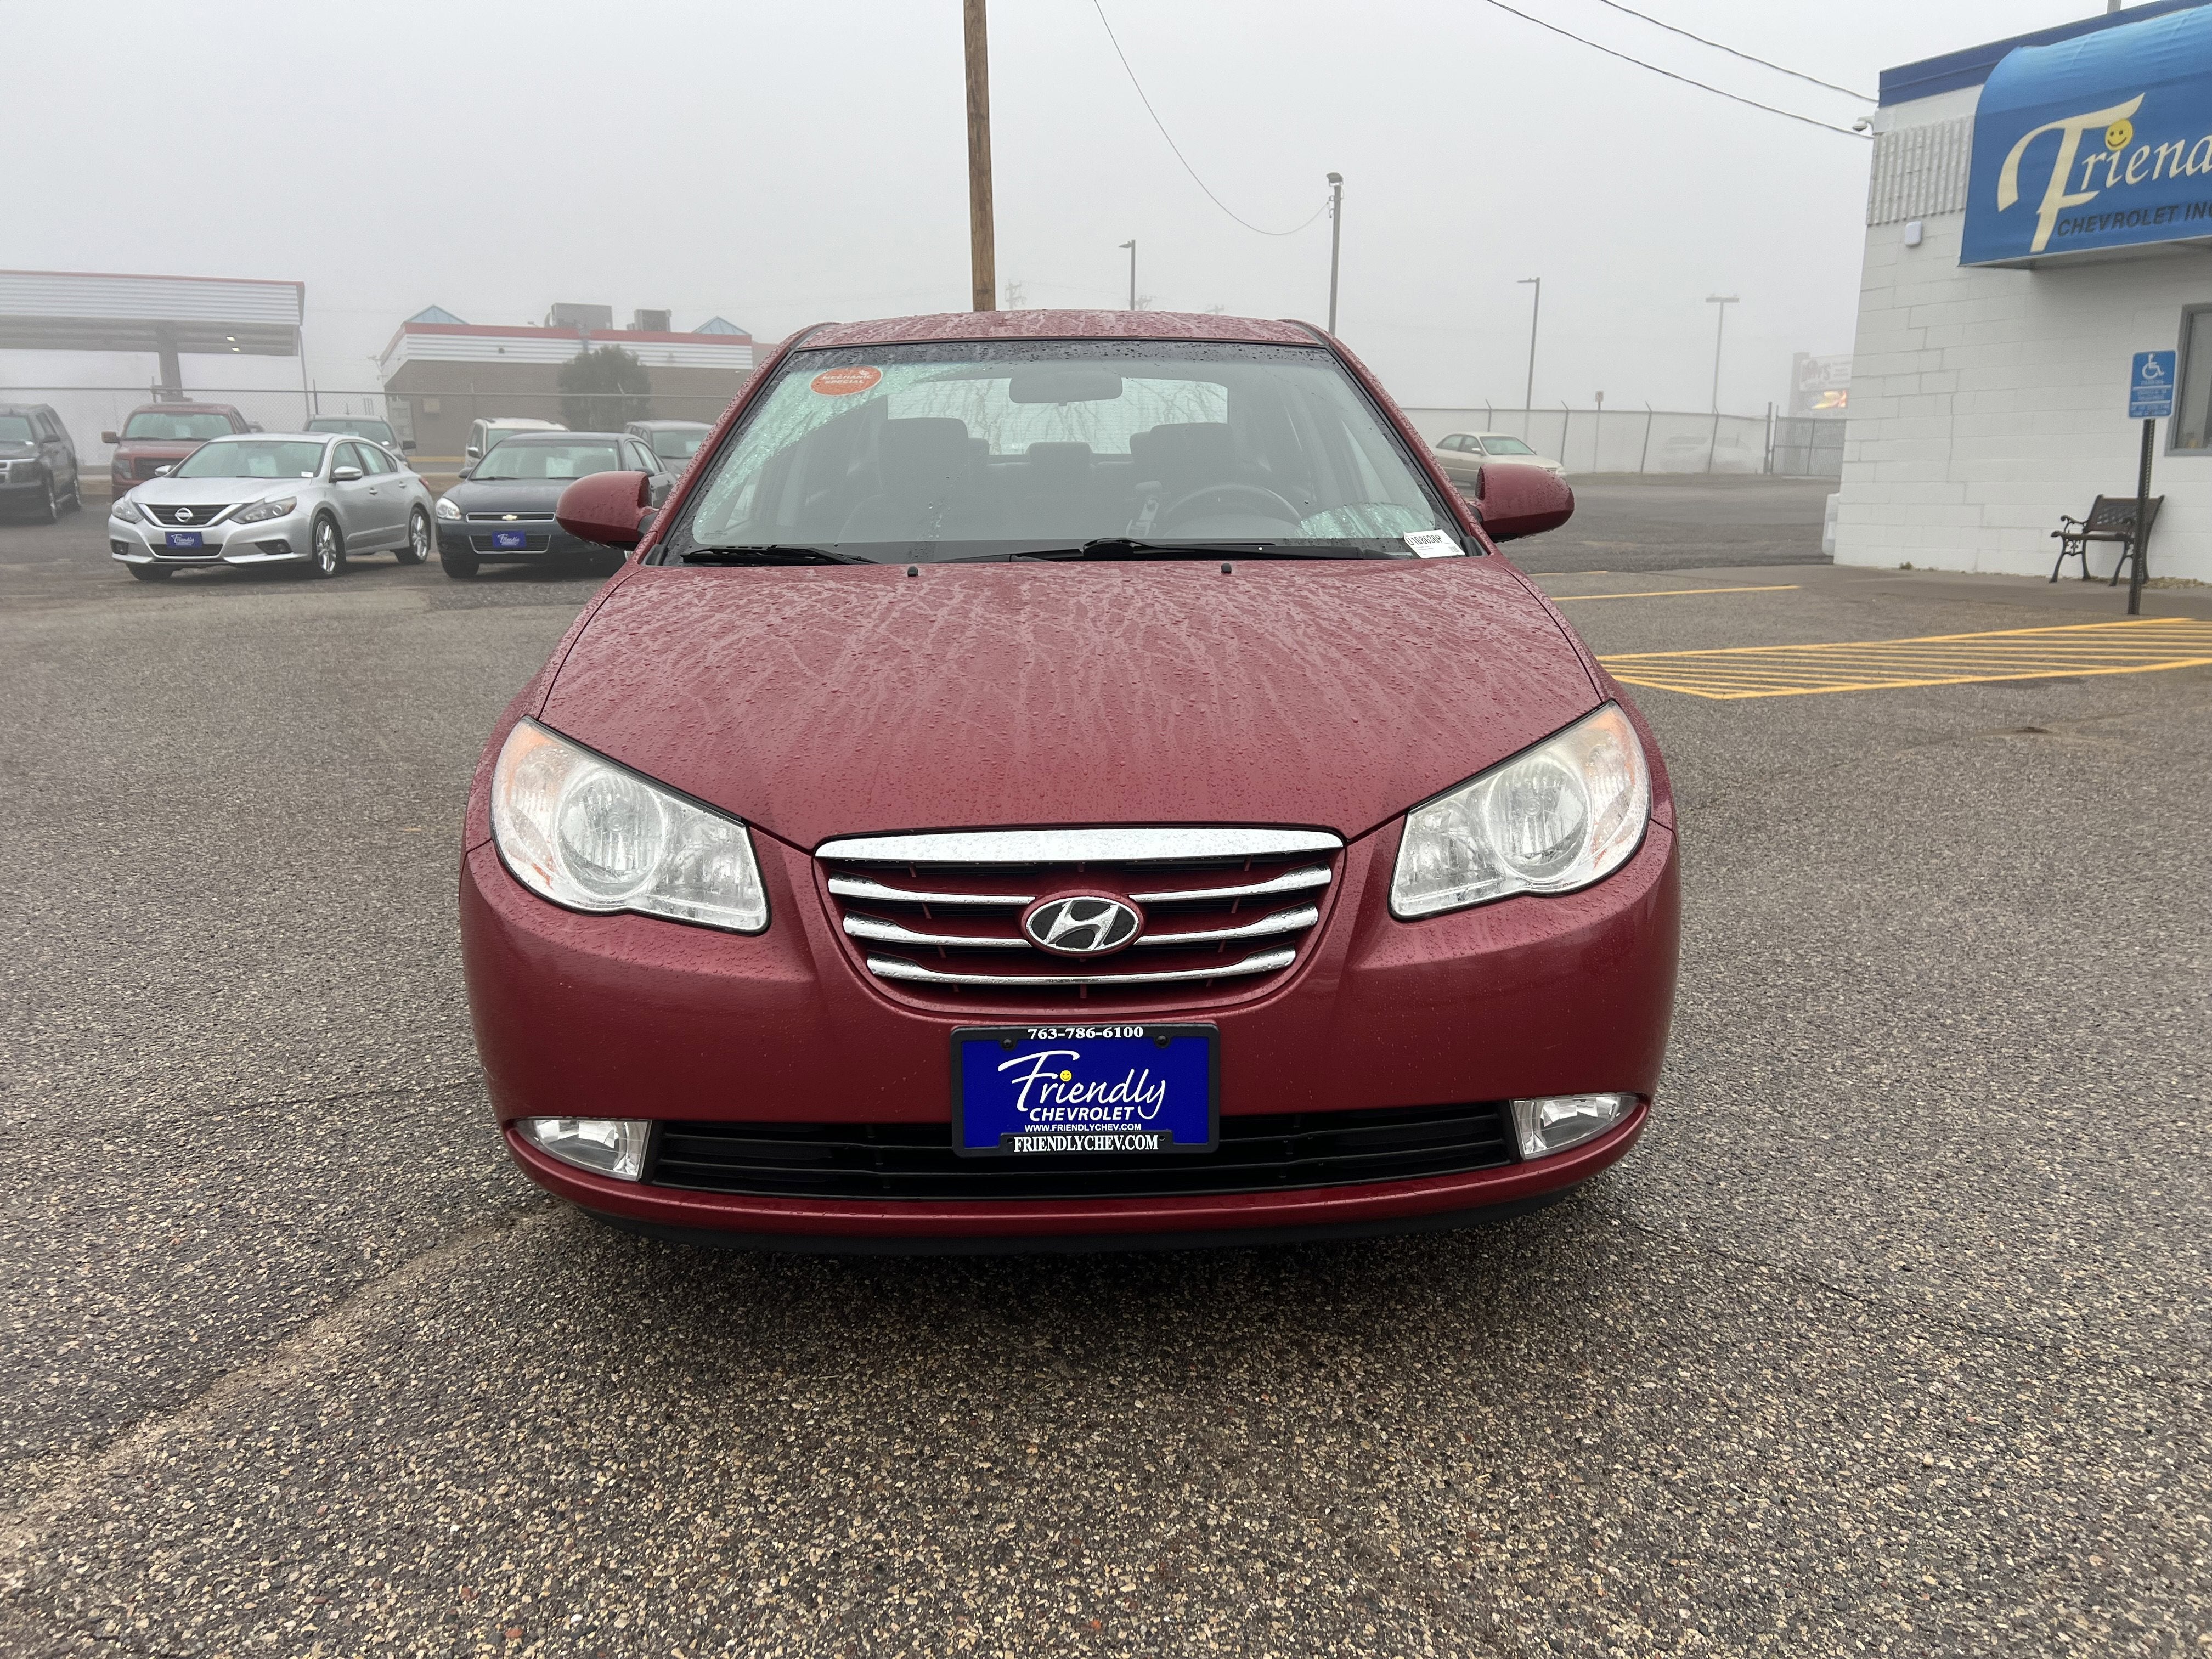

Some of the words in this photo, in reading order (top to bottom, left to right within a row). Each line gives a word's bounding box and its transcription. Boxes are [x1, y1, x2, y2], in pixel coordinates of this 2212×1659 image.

[2058, 205, 2179, 236] CHEVROLET
[2185, 201, 2212, 221] IN
[1405, 534, 1442, 546] U108630P
[1027, 1026, 1144, 1040] 763-786-6100
[998, 1050, 1166, 1120] Friendly
[1029, 1107, 1135, 1121] CHEVROLET
[1025, 1123, 1142, 1132] WWW.FRIENDLYCHEV.COM
[1014, 1134, 1159, 1153] FRIENDLYCHEV.COM
